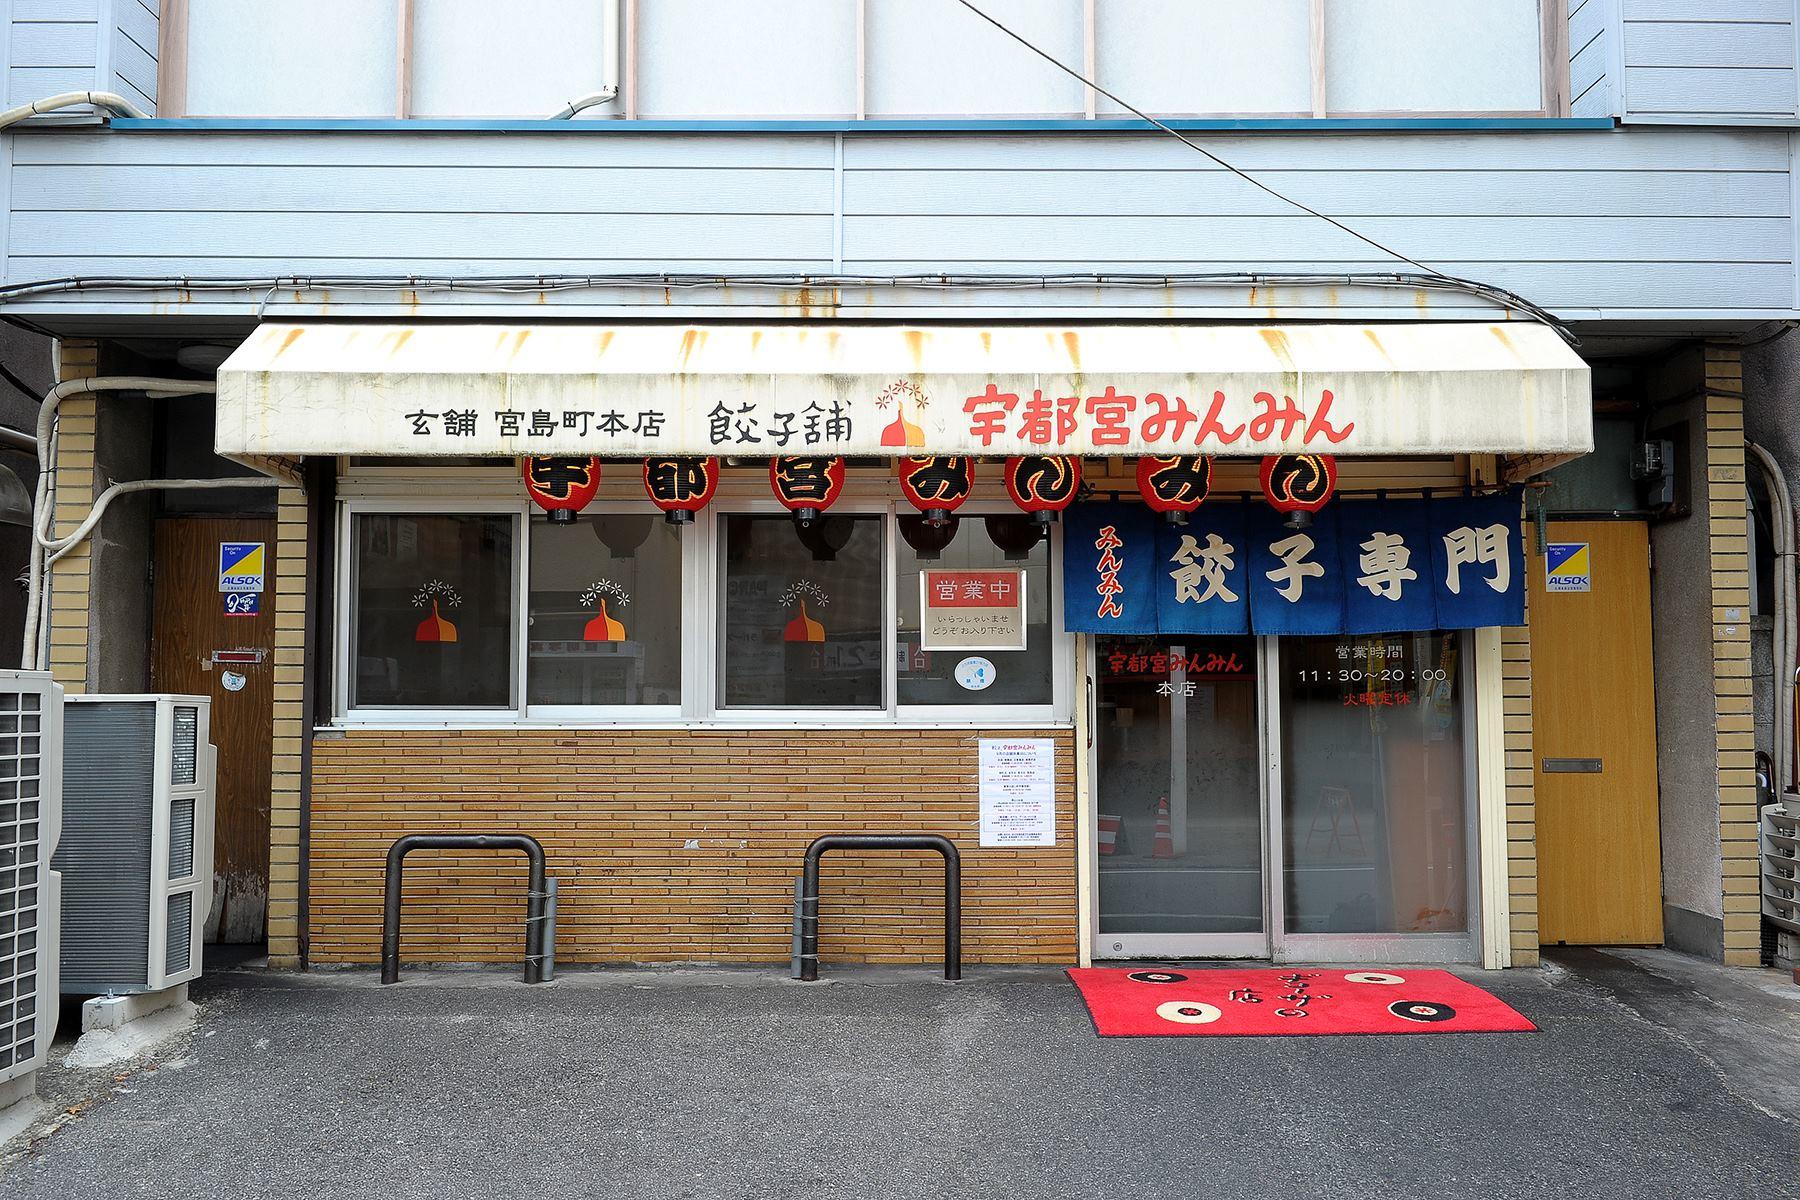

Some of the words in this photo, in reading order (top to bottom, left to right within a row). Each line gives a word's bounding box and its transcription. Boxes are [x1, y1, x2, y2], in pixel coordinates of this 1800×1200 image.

[404, 408, 478, 437] 玄舗
[495, 408, 666, 437] 宮島町本店
[708, 400, 852, 446] 餃子舗
[963, 383, 1354, 446] 宇都宮みんみん
[1095, 525, 1124, 619] みんみん
[1169, 523, 1512, 604] 餃子専門
[222, 577, 261, 585] ALSOK
[936, 580, 1010, 600] 営業中
[1549, 577, 1588, 585] ALSOK
[937, 615, 1009, 623] いらっしゃいませ
[1108, 651, 1243, 673] 宇都宮みんみん
[1335, 645, 1403, 659] 営業時間
[1156, 681, 1197, 697] 本店
[1343, 692, 1411, 707] 火曜定休
